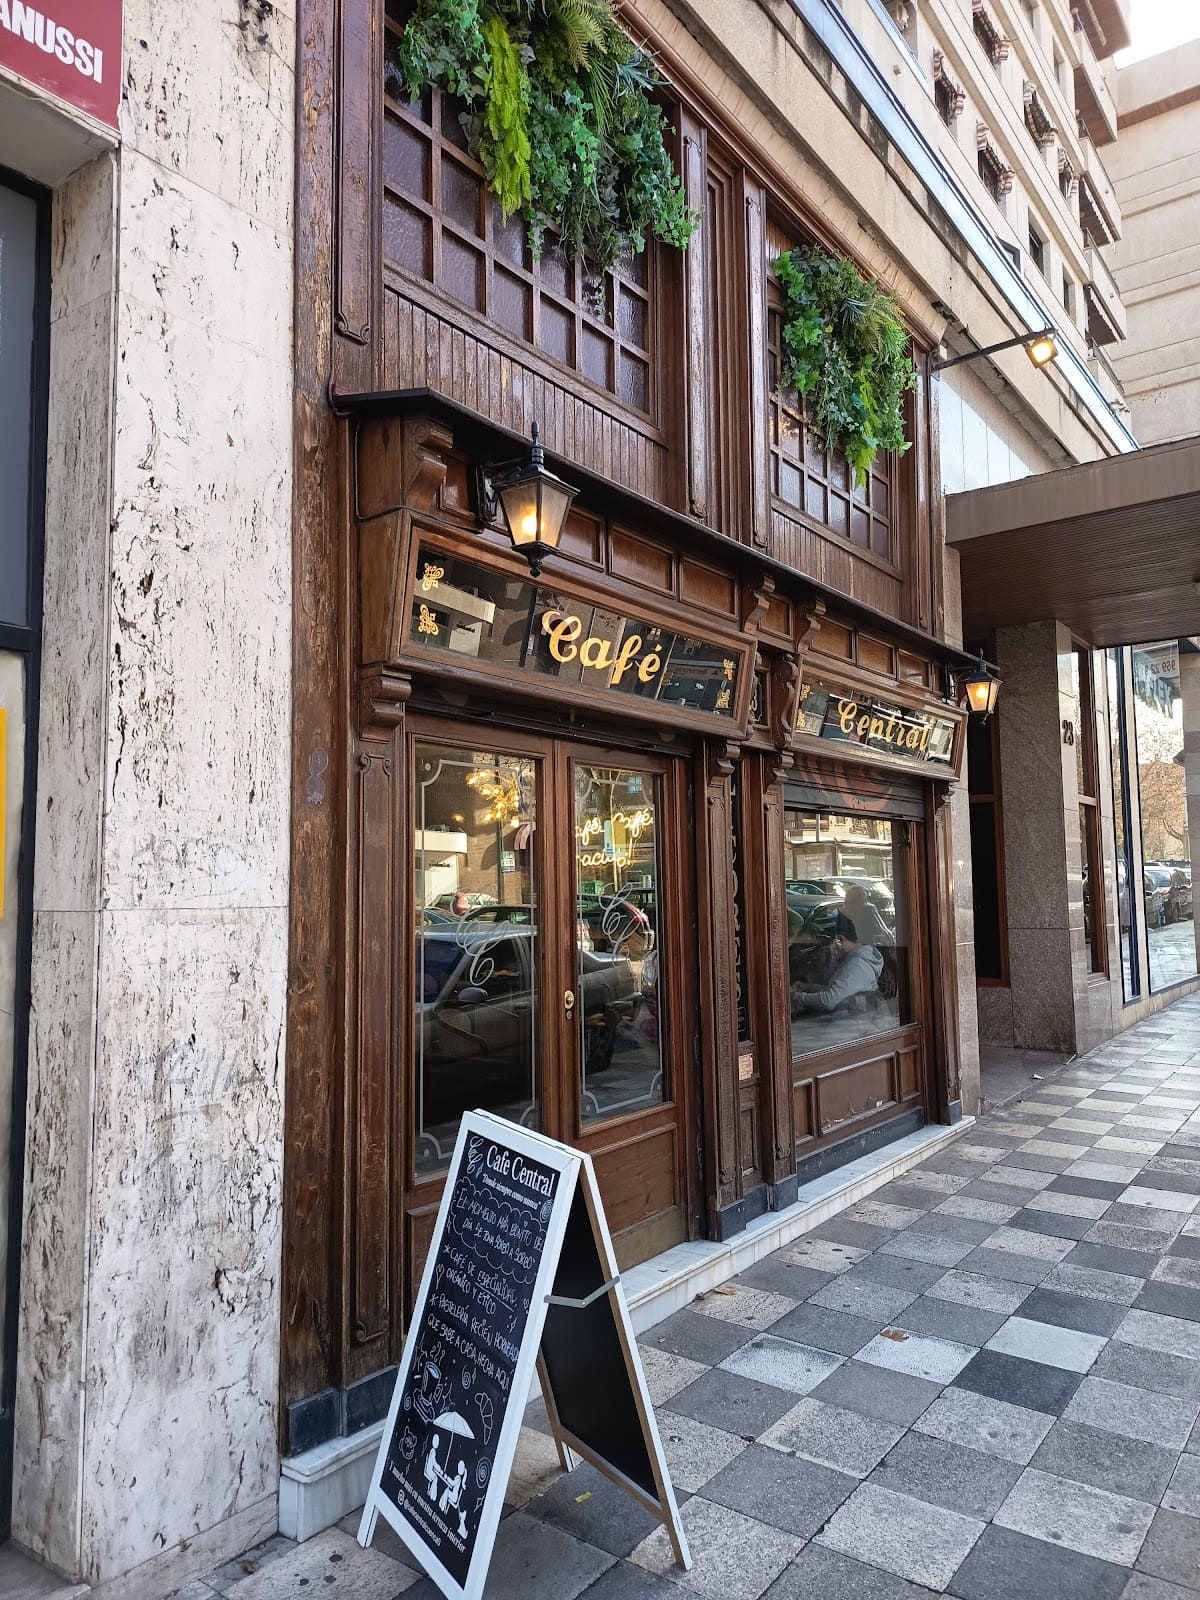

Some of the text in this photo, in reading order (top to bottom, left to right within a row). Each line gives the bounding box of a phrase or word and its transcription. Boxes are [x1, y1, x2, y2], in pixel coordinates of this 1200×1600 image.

[541, 609, 661, 688] Café
[837, 699, 929, 753] Central
[487, 1145, 556, 1197] Cafe Central
[468, 1200, 497, 1225] MOMENTO
[509, 1222, 533, 1246] BONITO
[474, 1222, 483, 1238] SE
[450, 1247, 469, 1269] CAFÉ
[468, 1261, 476, 1276] DE
[427, 1313, 440, 1331] QUE
[440, 1324, 456, 1345] SABE
[439, 1293, 470, 1327] PASTELERÍA
[470, 1317, 493, 1346] RECIÉN
